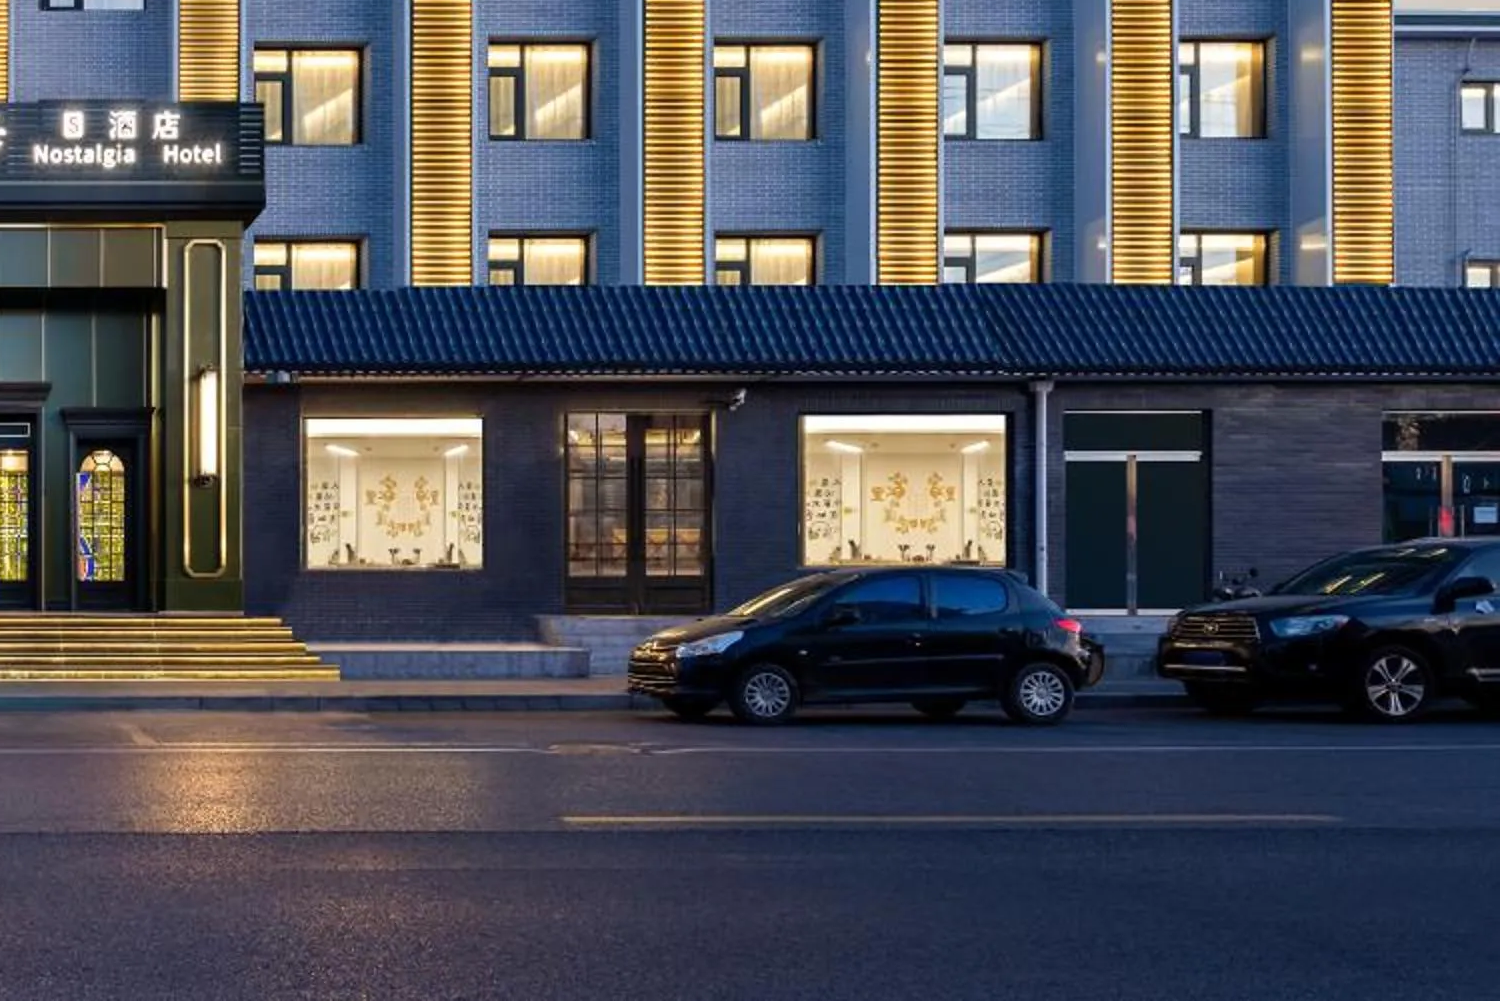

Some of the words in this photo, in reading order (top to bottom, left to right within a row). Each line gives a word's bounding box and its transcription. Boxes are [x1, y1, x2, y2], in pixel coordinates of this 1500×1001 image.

[109, 110, 181, 140] 酒店
[33, 143, 136, 169] Nostalgia
[163, 143, 222, 164] Hotel
